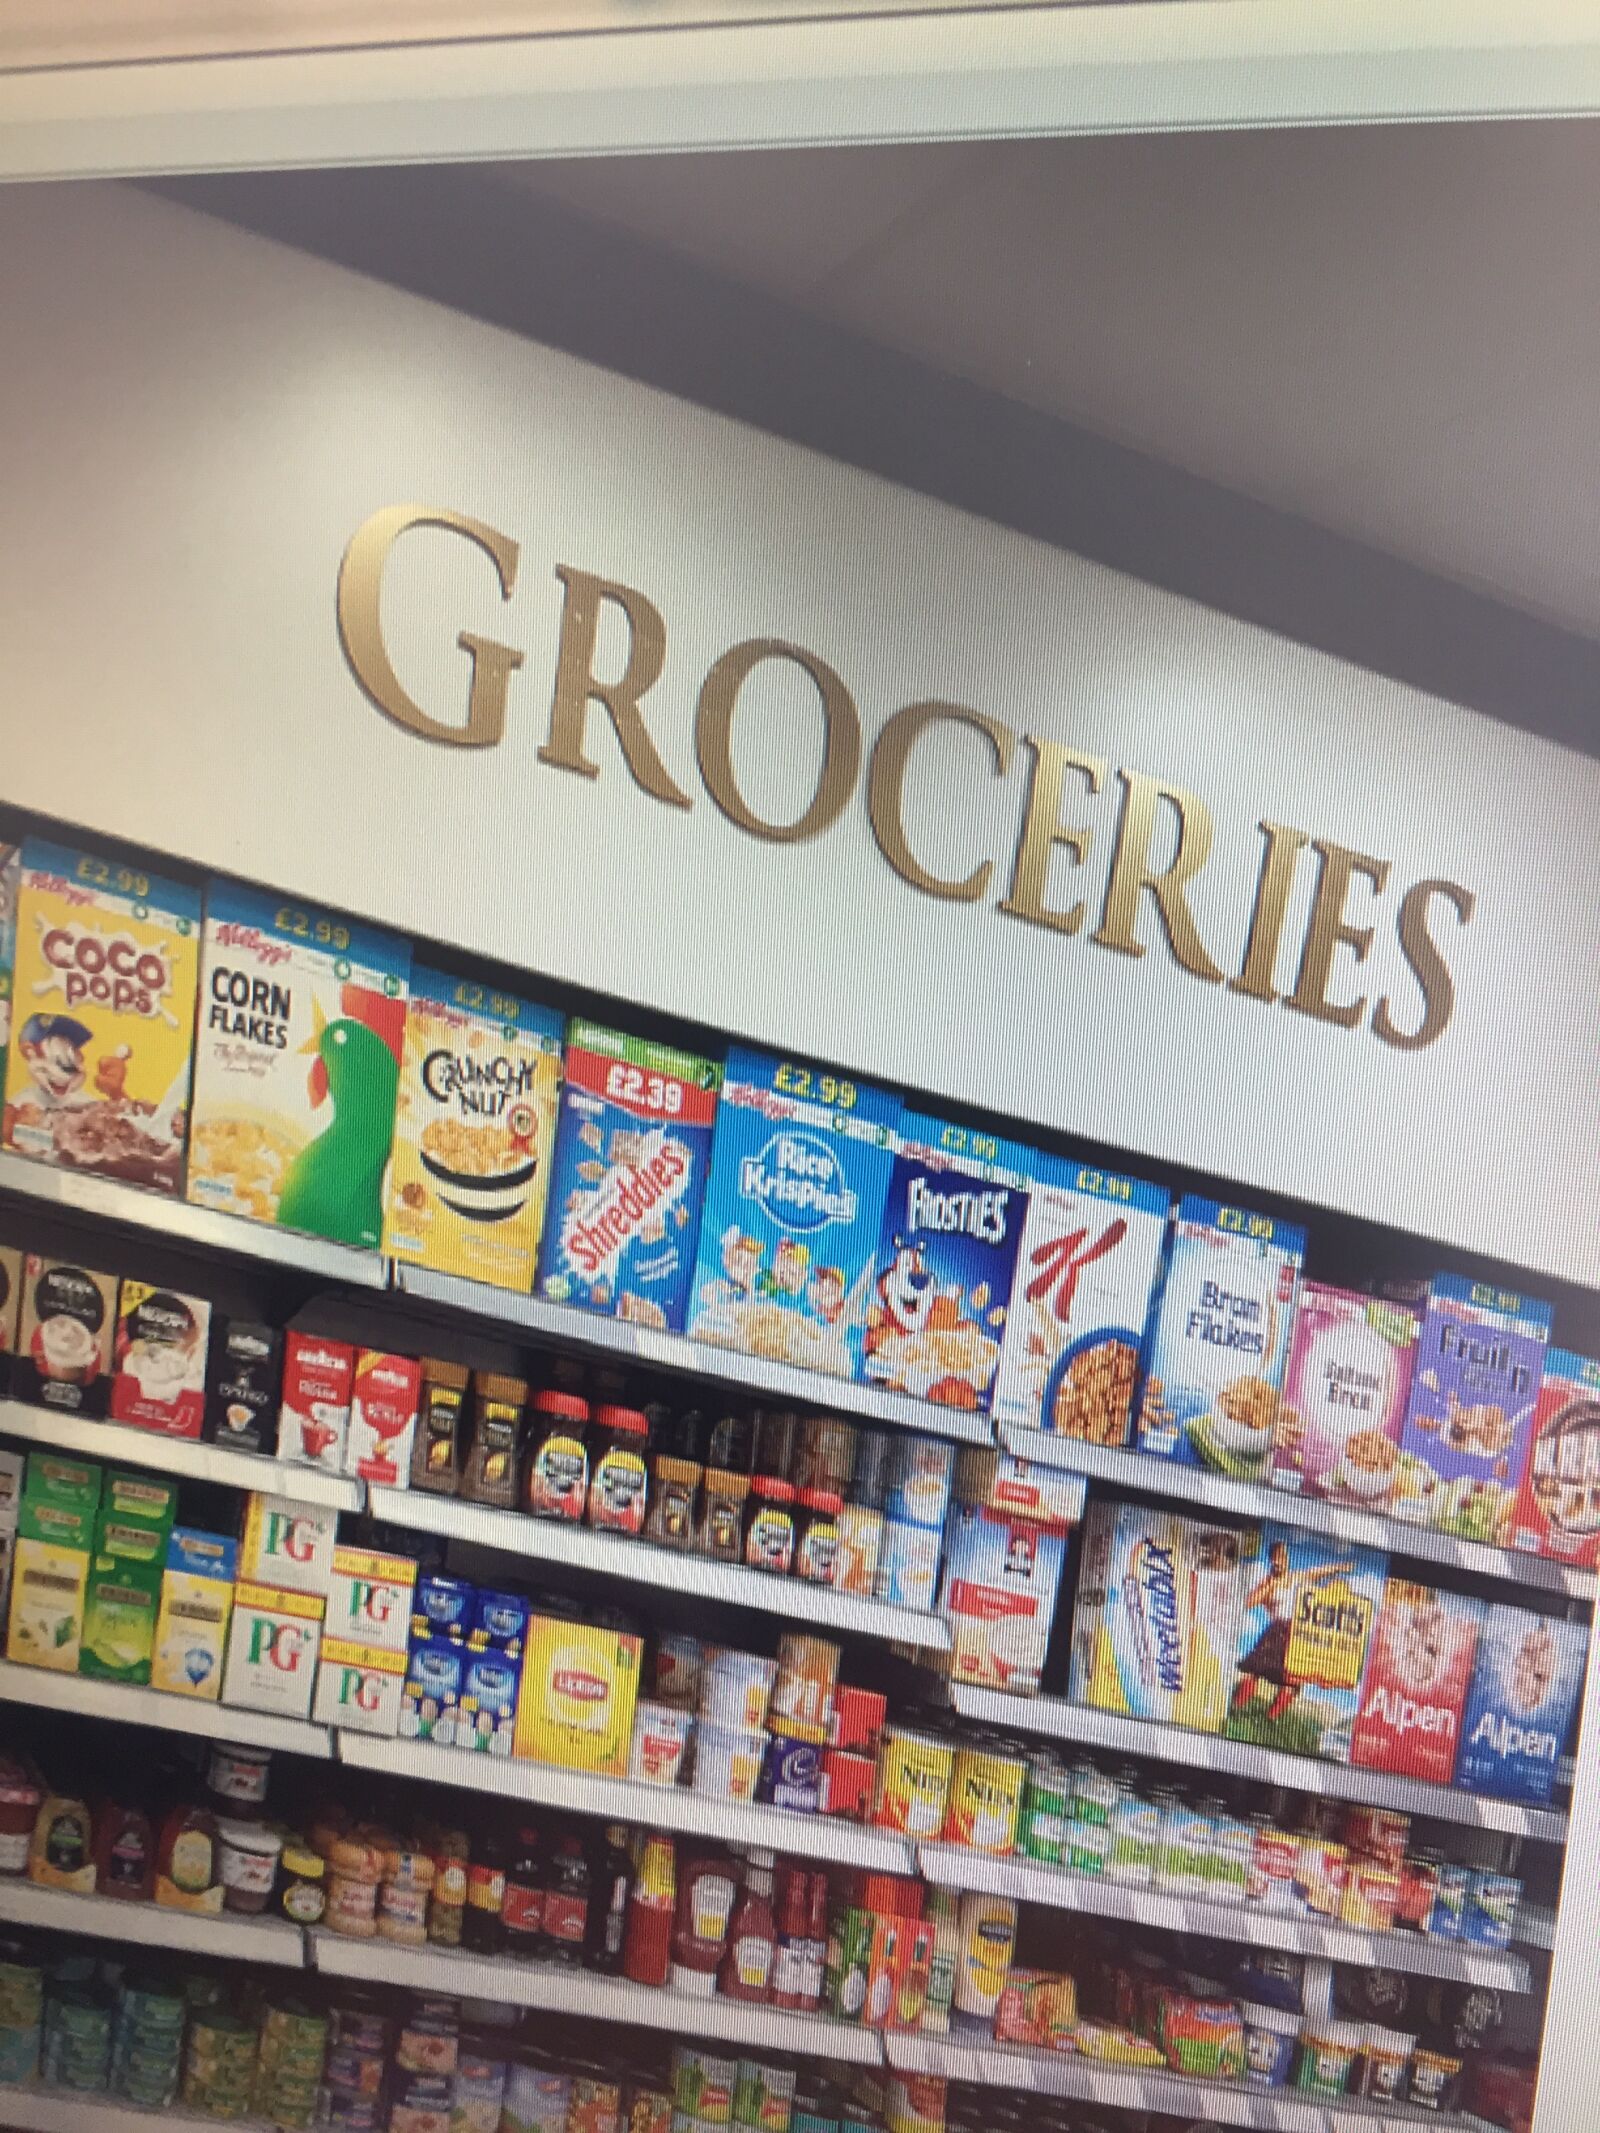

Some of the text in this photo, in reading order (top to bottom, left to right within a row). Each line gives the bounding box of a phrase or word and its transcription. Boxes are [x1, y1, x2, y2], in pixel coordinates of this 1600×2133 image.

[335, 501, 1477, 1051] GROCERIES
[77, 859, 149, 898] £2.99
[275, 907, 350, 951] £2.99
[42, 929, 166, 990] COCO
[211, 966, 292, 1021] CORN
[454, 982, 520, 1019] £2.99
[209, 1004, 289, 1051] FLAKES
[422, 1049, 538, 1103] CRUNCHY
[606, 1064, 684, 1114] £2.39
[774, 1063, 857, 1110] £2.99
[459, 1090, 509, 1117] NUT
[778, 1137, 833, 1178] Rice
[941, 1126, 997, 1159] £2.99
[745, 1163, 855, 1221] Krispies
[1076, 1168, 1132, 1200] £2.99
[568, 1145, 685, 1272] Shreddies
[1217, 1206, 1275, 1240] £2.99
[1024, 1217, 1128, 1323] K
[1200, 1280, 1263, 1322] Bran
[1185, 1310, 1264, 1355] Flakes
[267, 1511, 315, 1562] PG
[349, 1580, 390, 1623] PG
[248, 1617, 300, 1673] PG
[338, 1667, 380, 1713] PG
[1363, 1684, 1457, 1739] Alpen
[1469, 1711, 1558, 1762] Alpen
